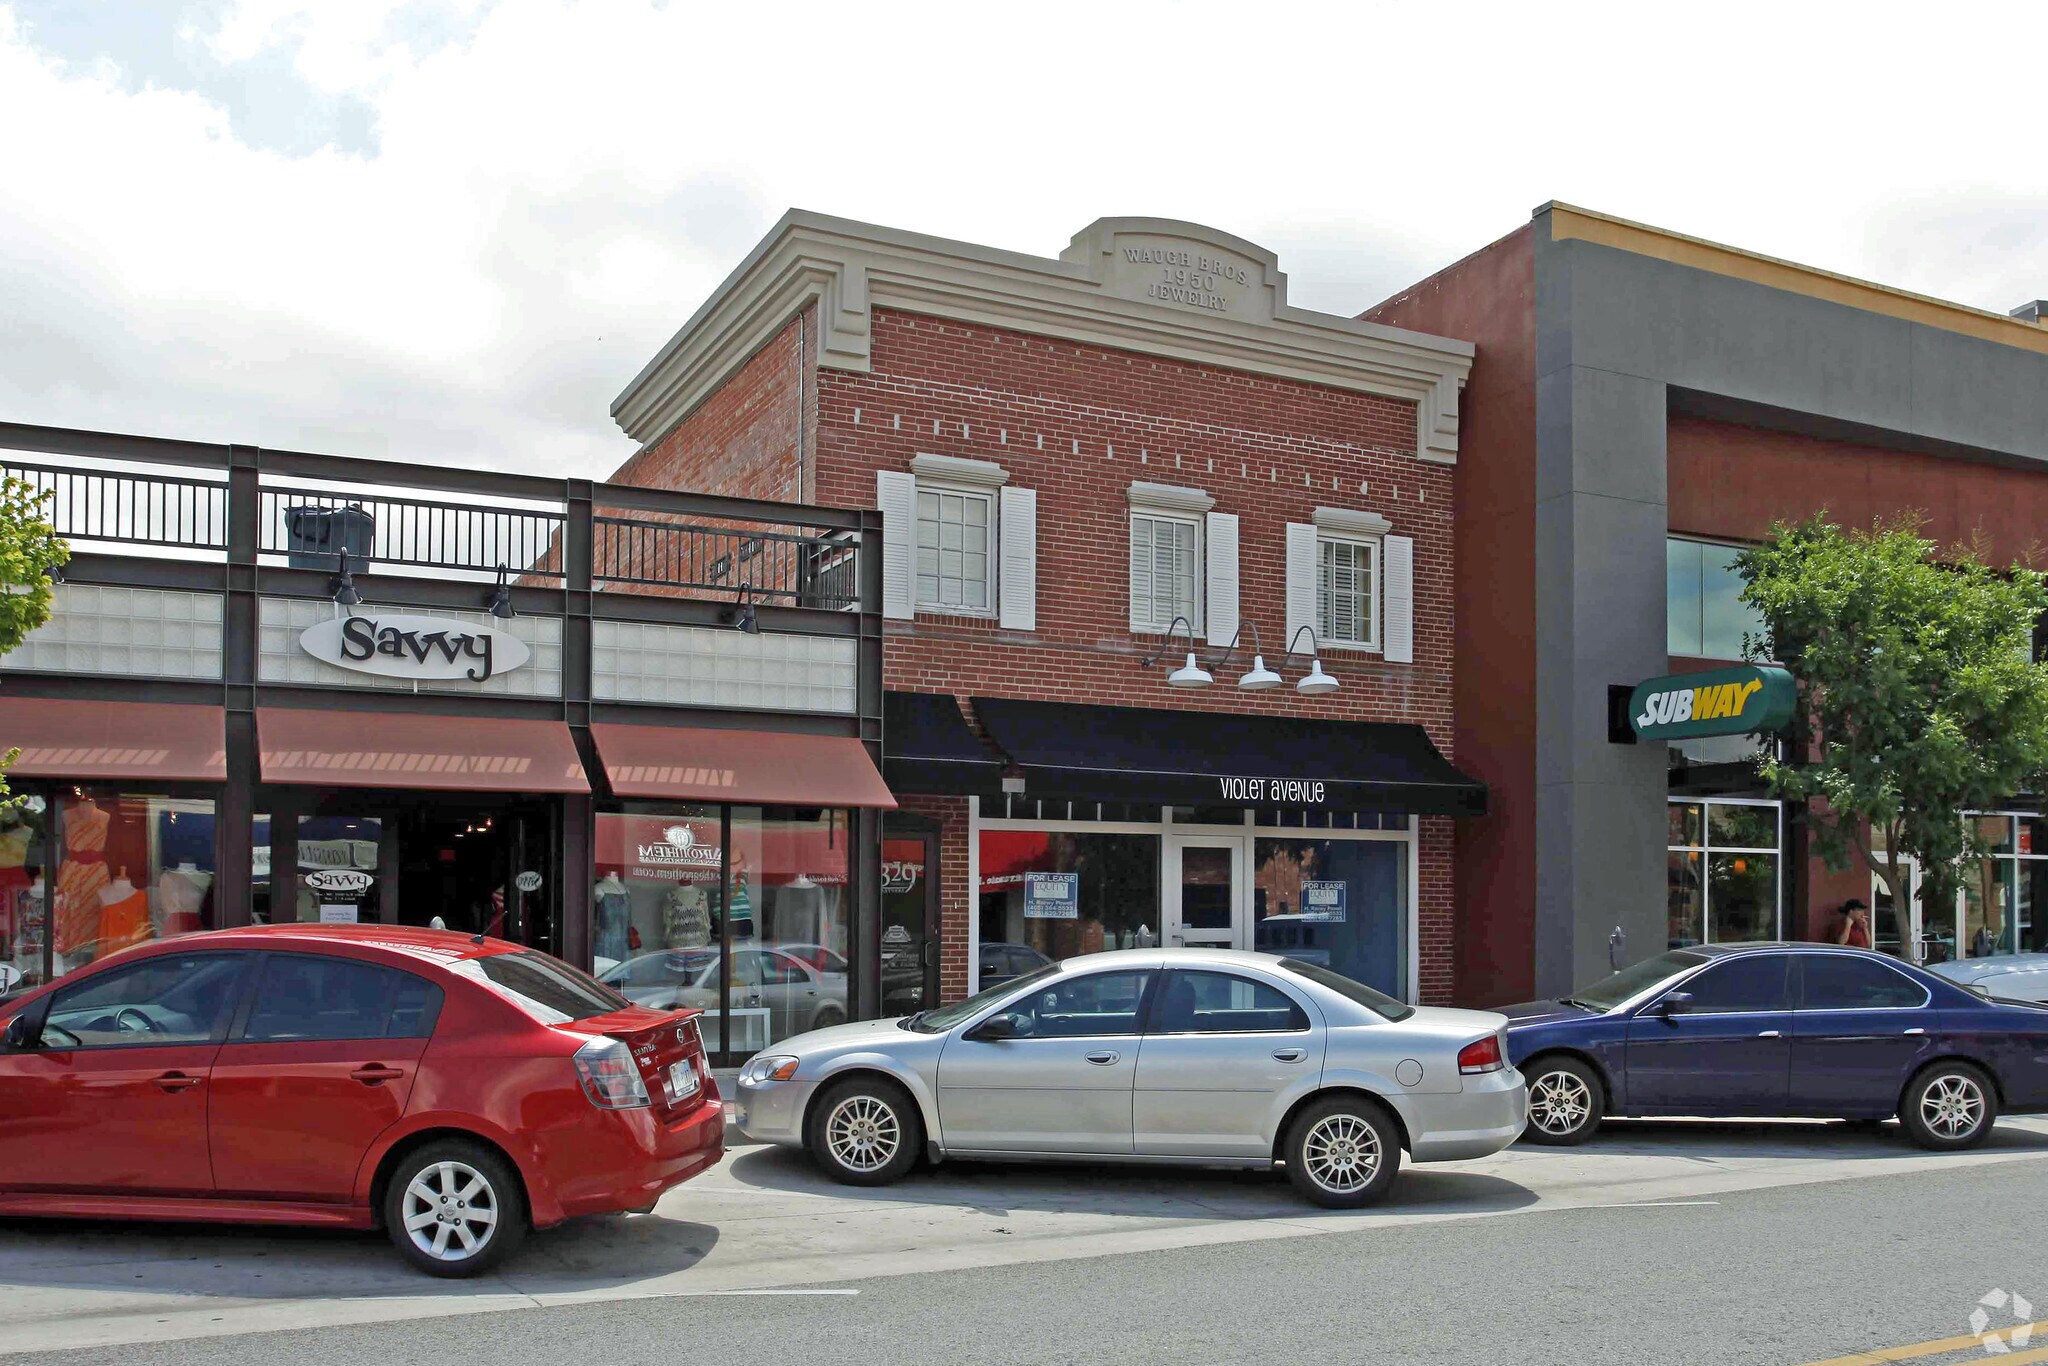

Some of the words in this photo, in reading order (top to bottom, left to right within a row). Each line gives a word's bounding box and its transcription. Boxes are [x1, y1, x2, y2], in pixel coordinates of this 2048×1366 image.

[1124, 248, 1191, 267] WAUGH
[1198, 256, 1250, 288] BROS.
[1164, 268, 1215, 291] 1950
[1148, 284, 1228, 312] JEWELRY
[340, 616, 493, 682] Savvy
[1636, 677, 1763, 729] SUBWAY
[311, 872, 368, 892] Savvy
[1035, 883, 1067, 892] EQUITY
[1048, 875, 1076, 883] LEASE
[1311, 890, 1336, 898] EQUITY
